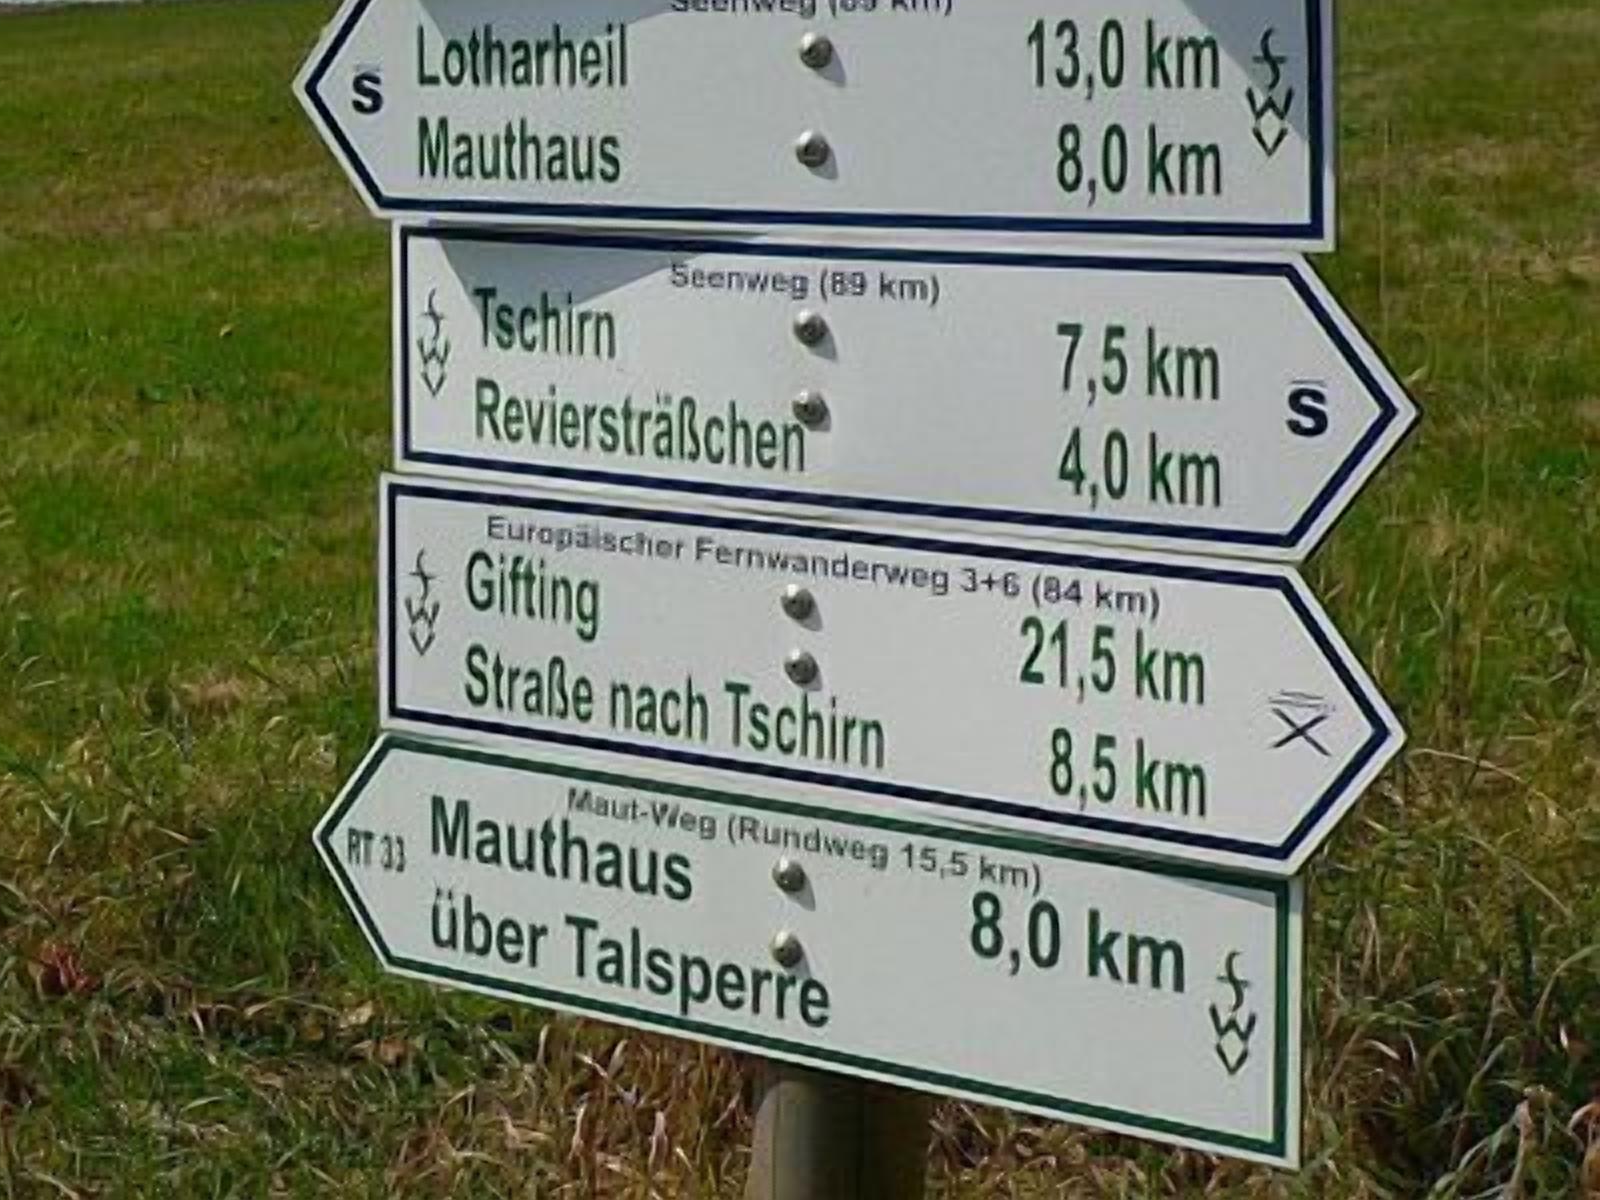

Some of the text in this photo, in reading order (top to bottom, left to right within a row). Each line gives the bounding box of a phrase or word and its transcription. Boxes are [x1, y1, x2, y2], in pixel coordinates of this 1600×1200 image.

[351, 72, 383, 114] S
[416, 17, 1220, 100] Lotharheil 13,0 km
[417, 116, 1222, 207] Mauthaus 8,0 km
[671, 262, 808, 300] Seenweg
[879, 272, 941, 306] km)
[473, 287, 1220, 406] Tschirn 7,5 km
[475, 378, 1221, 510] Reviersträßchen 4,0 km
[1286, 388, 1329, 437] S
[488, 515, 1160, 621] Europäischer Fernwanderweg 3+6 (84 km)
[465, 550, 1205, 705] Gifting 21,5 km
[464, 644, 1206, 818] Straße nach Tschirn 8,5 km
[430, 795, 1184, 993] Mauthaus 8,0 km
[568, 787, 1041, 896] Maut-Weg (Rundweg 15,5 km)
[431, 882, 830, 1029] über Talsperre
